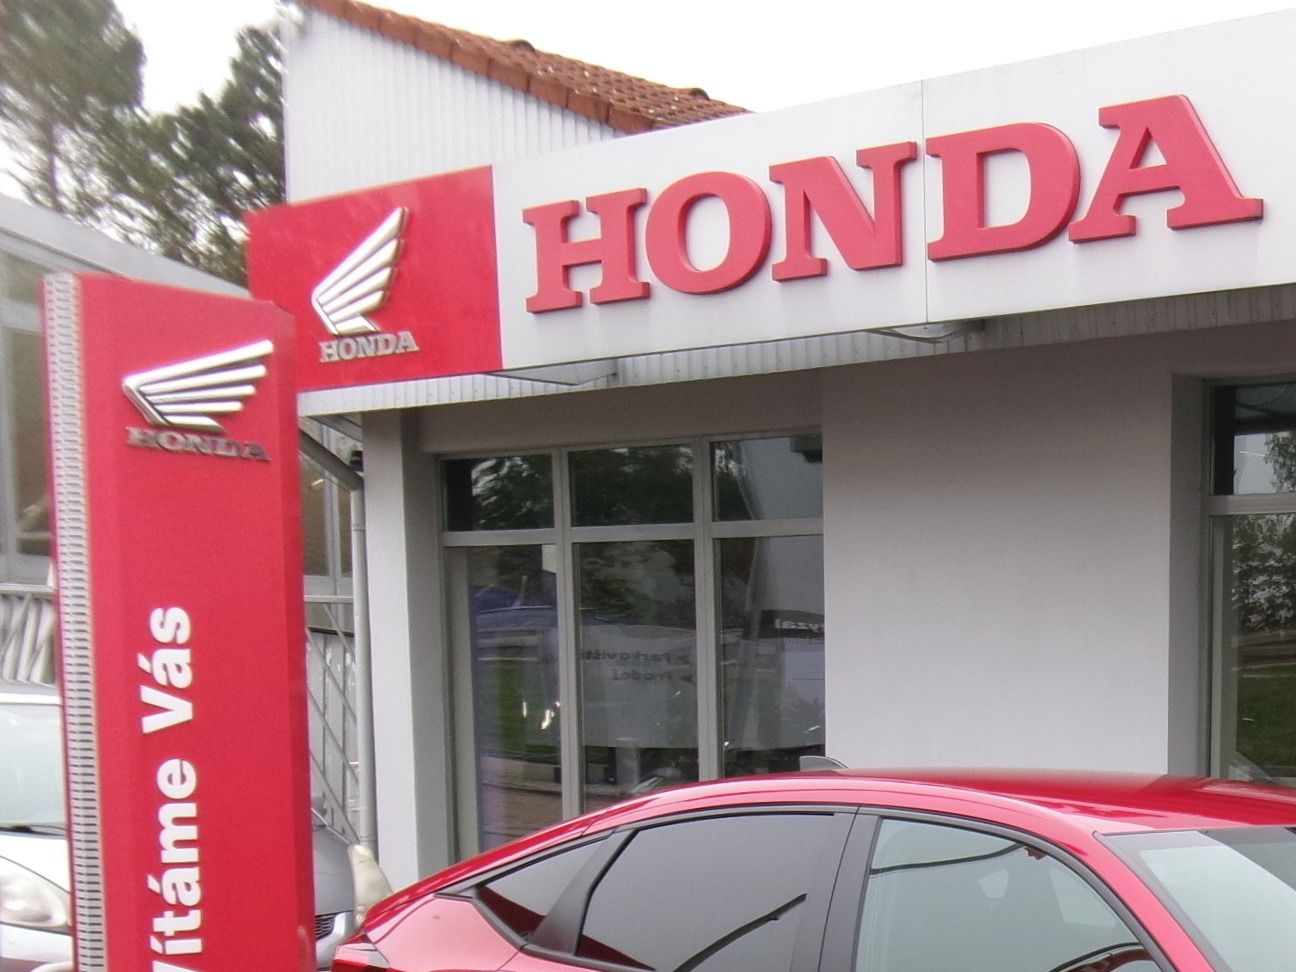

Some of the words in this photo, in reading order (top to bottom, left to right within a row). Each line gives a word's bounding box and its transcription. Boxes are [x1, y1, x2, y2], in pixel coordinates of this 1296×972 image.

[522, 94, 1264, 314] HONDA
[319, 331, 420, 363] HONDA
[125, 427, 270, 462] HONDA
[137, 605, 194, 734] Vás
